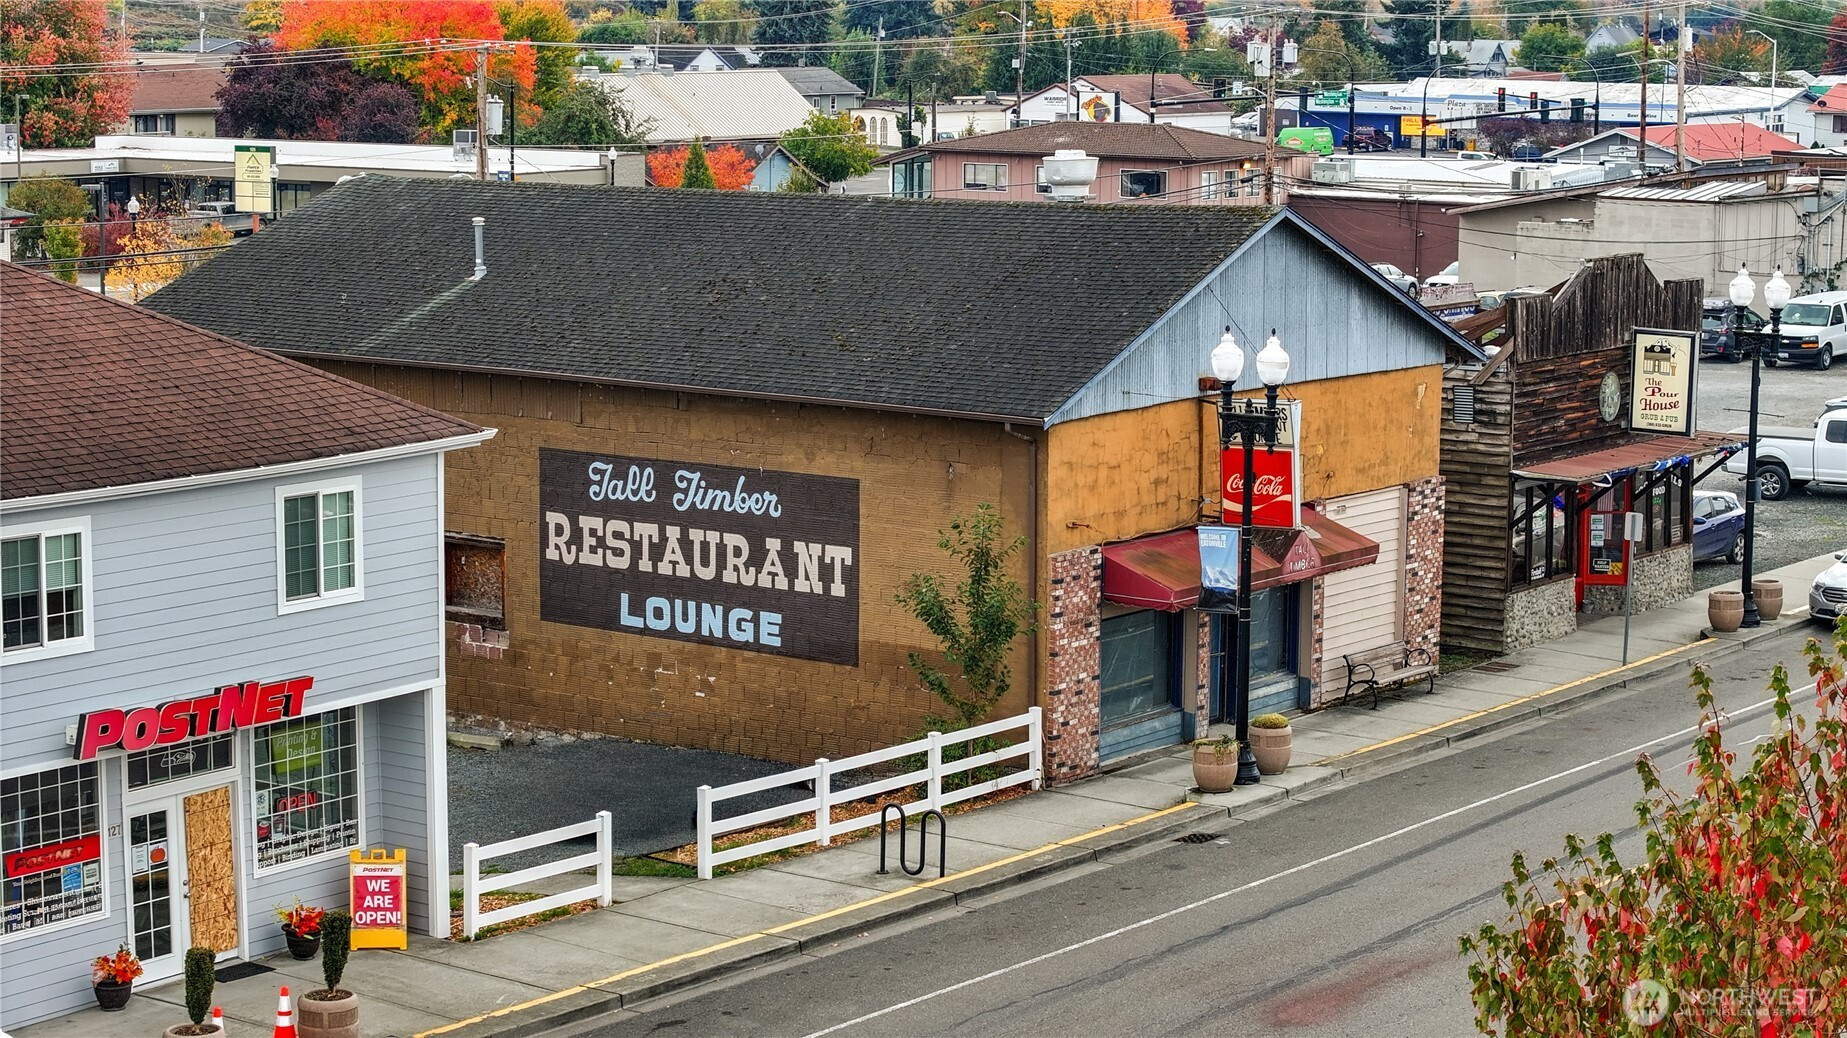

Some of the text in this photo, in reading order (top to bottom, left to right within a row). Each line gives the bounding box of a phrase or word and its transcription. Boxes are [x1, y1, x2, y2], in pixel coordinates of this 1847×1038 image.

[1447, 99, 1466, 107] Plaza
[1645, 377, 1662, 386] The
[1645, 386, 1679, 398] Pour
[1639, 398, 1680, 411] House
[1640, 413, 1658, 421] GRUB
[1665, 415, 1679, 423] PUB
[588, 461, 782, 518] Tall Timber
[1226, 473, 1286, 496] CocCola
[1652, 486, 1666, 497] FOOD
[545, 511, 852, 598] RESTAURANT
[620, 592, 782, 647] LOUNGE
[276, 729, 318, 748] Printing &
[287, 745, 316, 758] Design
[278, 791, 318, 812] OPEN
[108, 825, 121, 838] 127
[366, 879, 391, 892] WE
[363, 895, 393, 908] ARE
[355, 911, 402, 924] OPEN!
